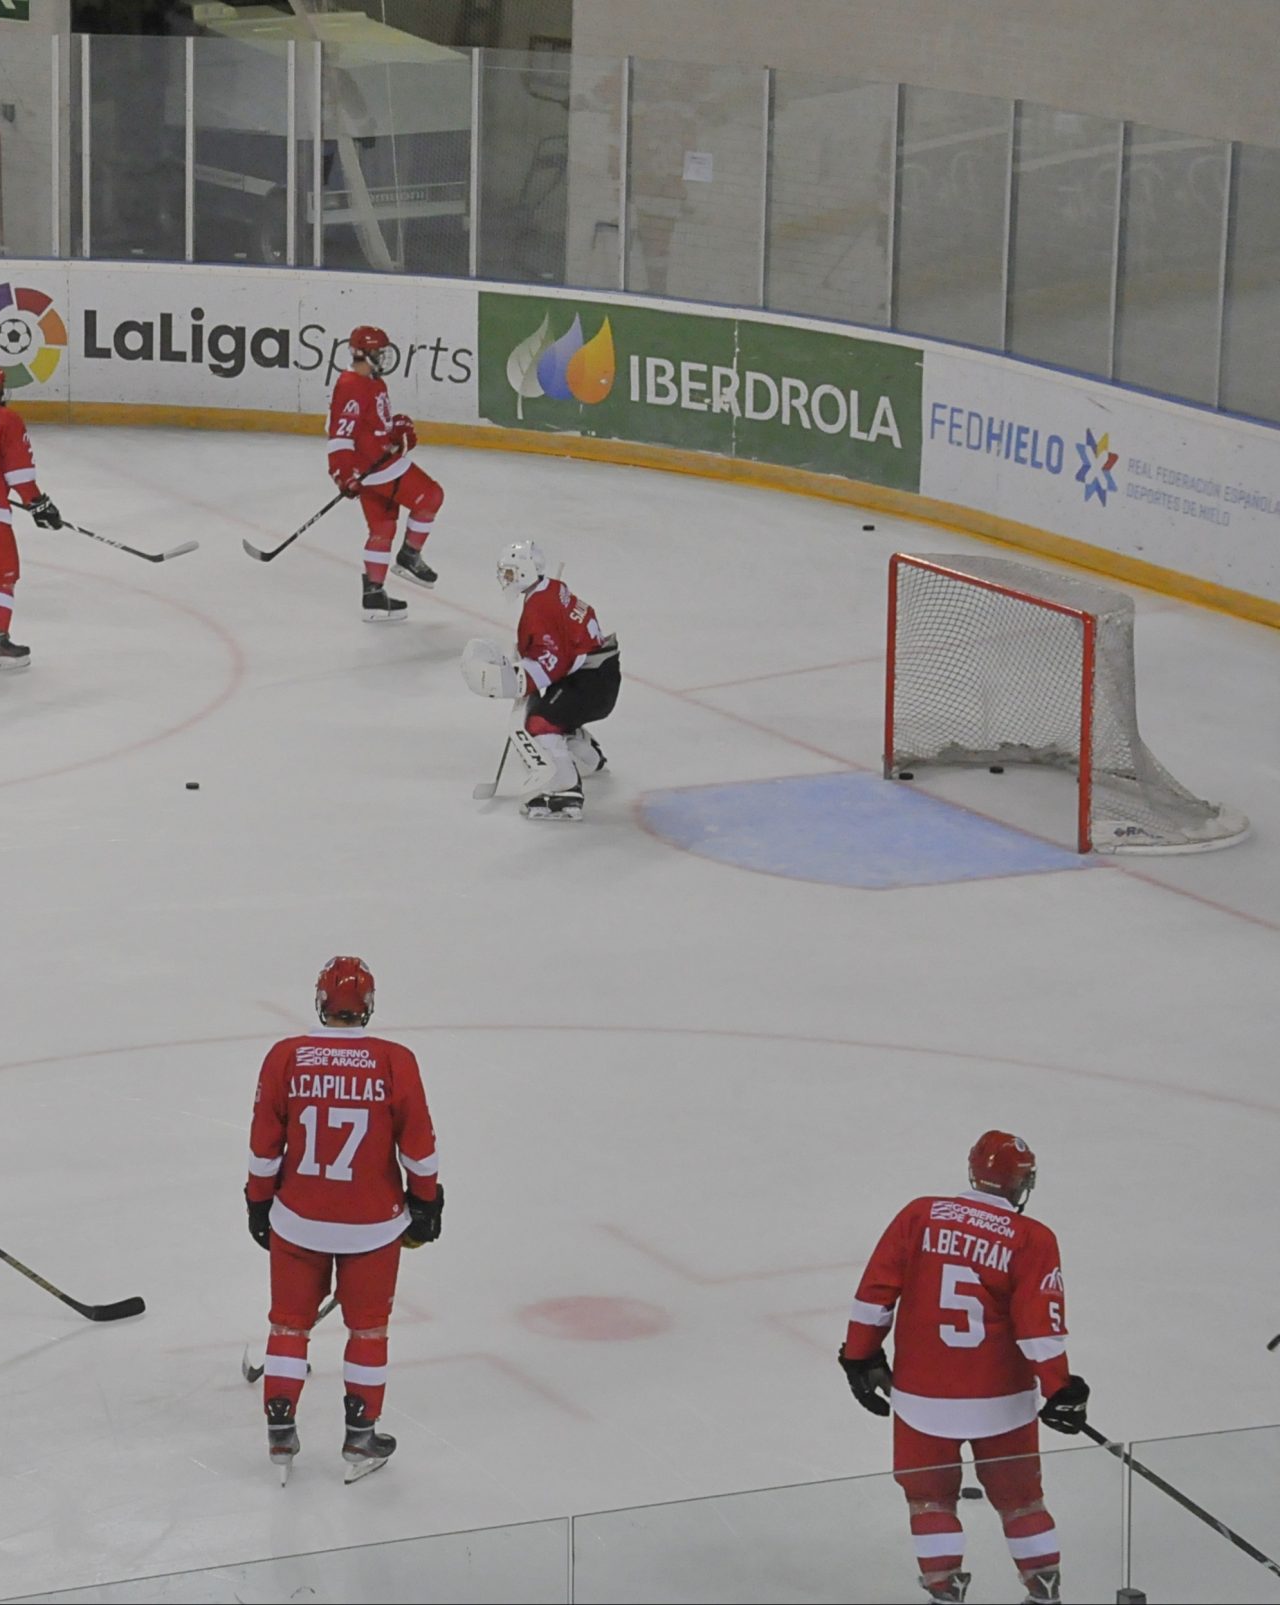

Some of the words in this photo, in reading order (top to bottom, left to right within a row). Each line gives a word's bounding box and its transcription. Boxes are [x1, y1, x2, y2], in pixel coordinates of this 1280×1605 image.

[629, 354, 903, 449] IBERDROLA
[336, 418, 355, 437] 24
[930, 402, 1065, 475] FEDHIELO
[1127, 457, 1153, 480] REAL
[516, 730, 547, 767] CCM
[313, 1057, 329, 1067] DE
[314, 1047, 370, 1059] GOBIERNO
[296, 1105, 370, 1182] 17
[952, 1203, 1012, 1226] GOBIERNO
[922, 1226, 1013, 1274] A.BETRÁN
[939, 1263, 986, 1349] 5
[1048, 1301, 1061, 1333] 5
